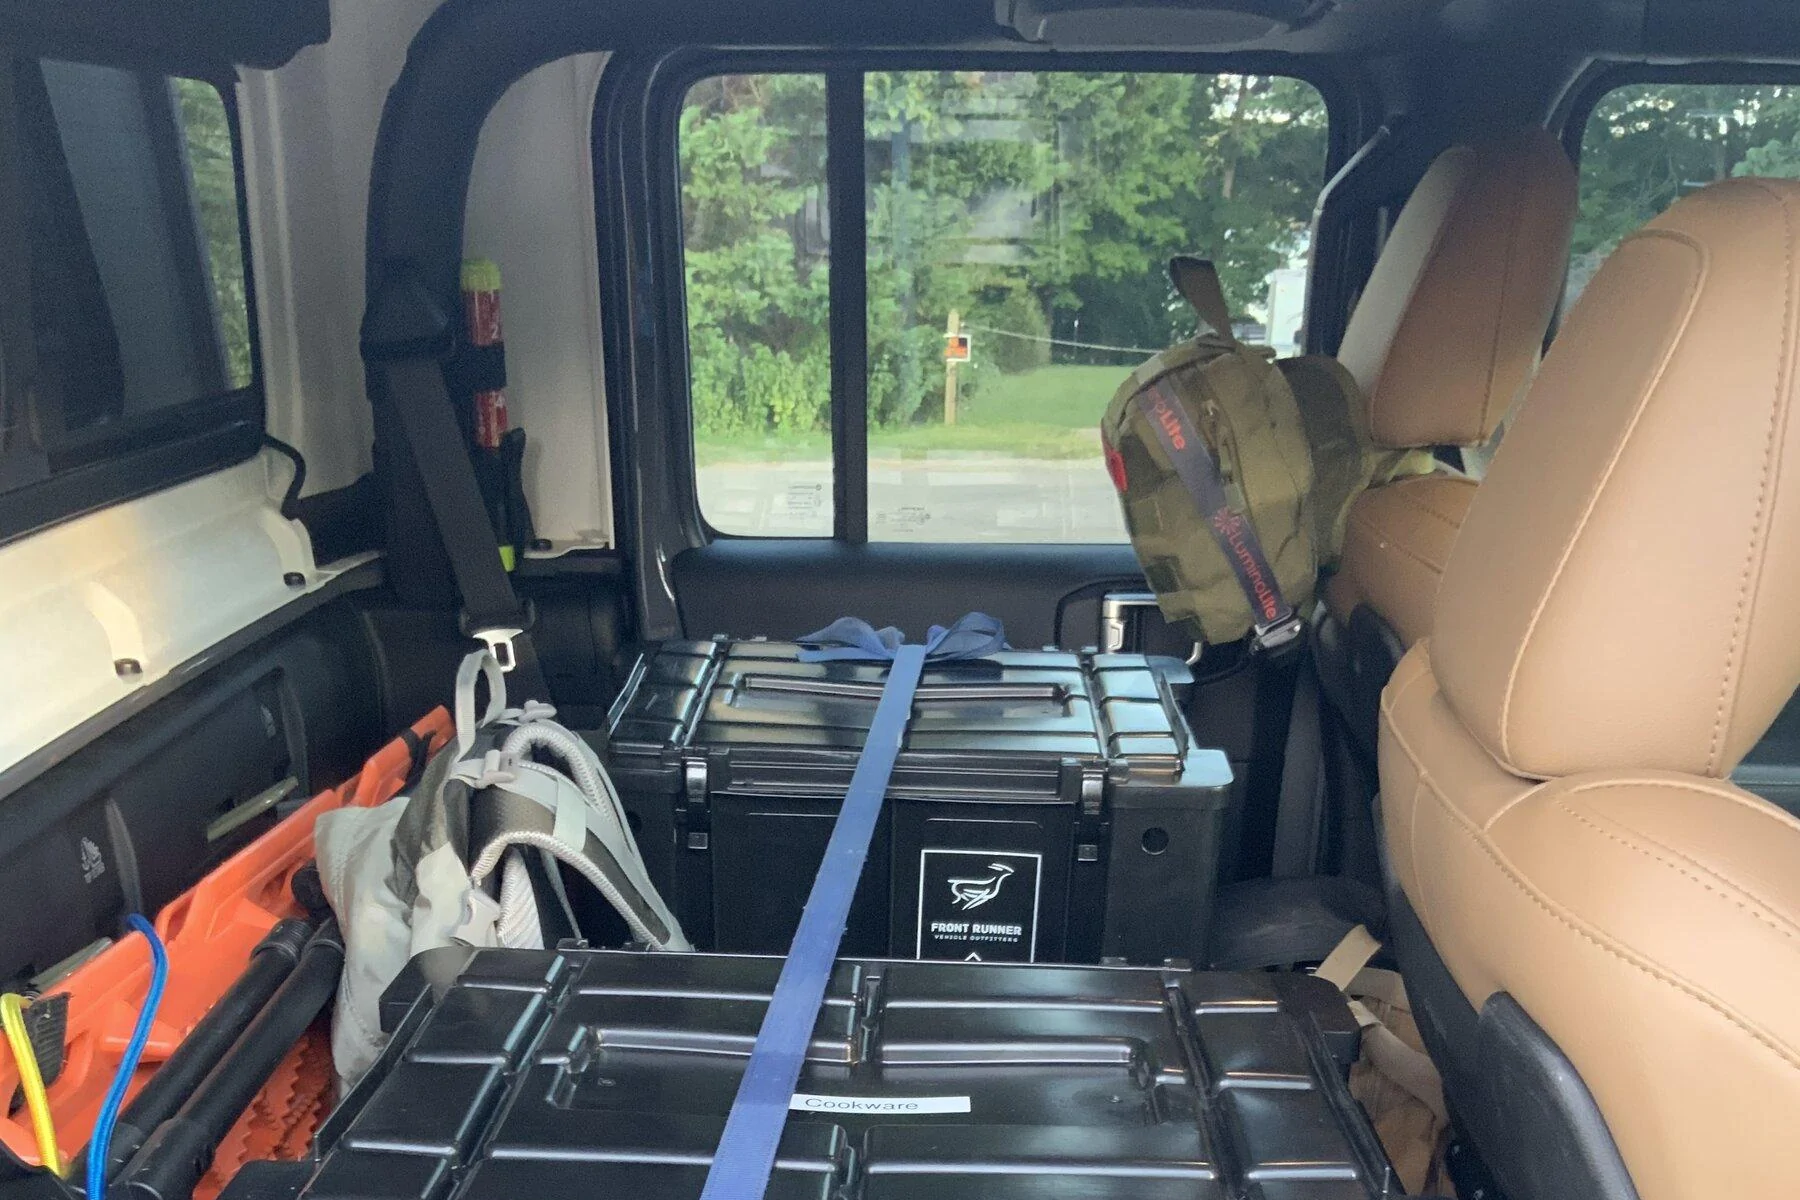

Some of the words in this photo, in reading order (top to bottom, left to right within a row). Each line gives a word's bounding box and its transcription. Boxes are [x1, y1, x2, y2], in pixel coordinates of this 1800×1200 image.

[930, 922, 970, 933] FRONT
[972, 924, 1022, 936] RUNNER
[969, 935, 1019, 943] OUTFITTERS
[805, 1098, 919, 1111] Cookware
